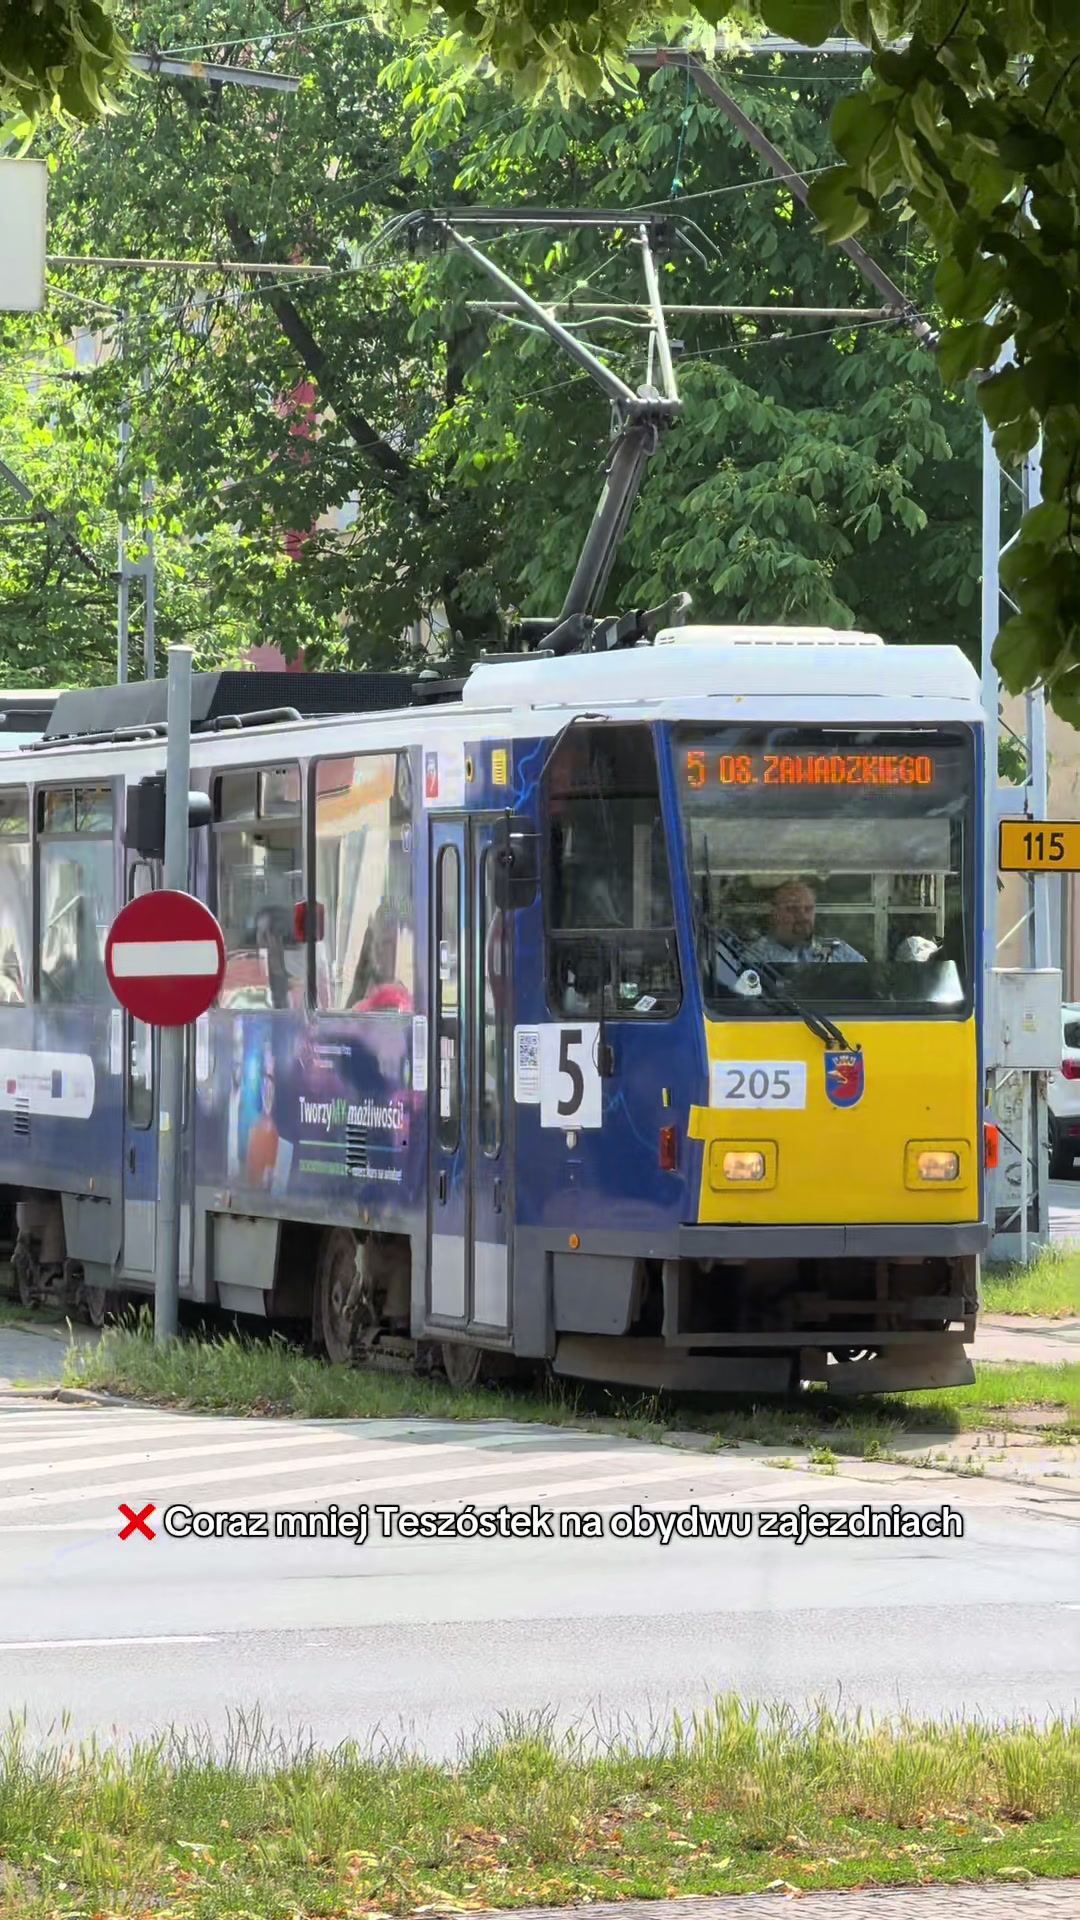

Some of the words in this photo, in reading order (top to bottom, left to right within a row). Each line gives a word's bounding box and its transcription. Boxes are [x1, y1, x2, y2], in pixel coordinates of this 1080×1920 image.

[687, 752, 705, 786] 5
[719, 755, 759, 785] OS.
[763, 755, 932, 785] ZAWADZKIEGO
[1023, 832, 1065, 861] 115
[557, 1029, 585, 1116] 5
[725, 1069, 791, 1099] 205
[347, 1098, 404, 1130] możliwości!
